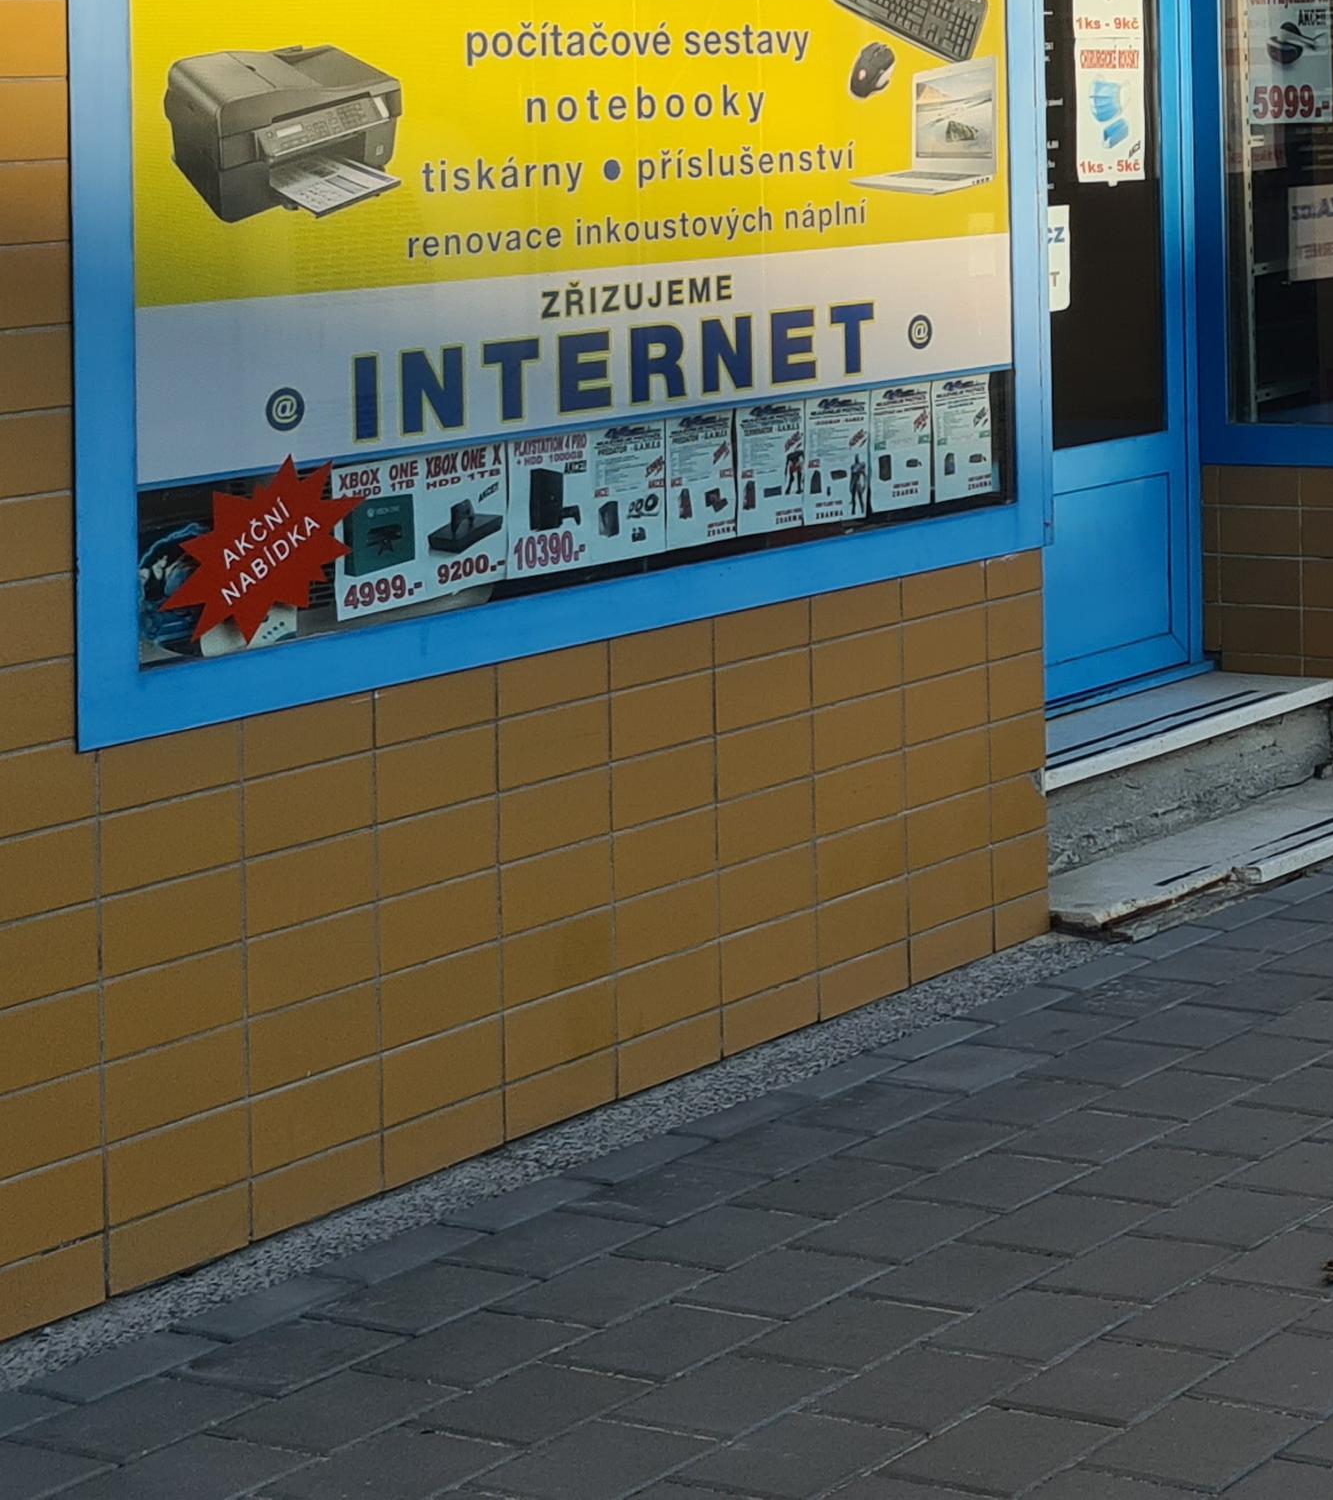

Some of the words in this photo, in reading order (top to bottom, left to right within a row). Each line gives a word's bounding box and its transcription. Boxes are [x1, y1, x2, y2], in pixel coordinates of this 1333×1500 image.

[465, 20, 673, 68] počítačové
[683, 26, 812, 62] sestavy
[1076, 18, 1101, 30] 1ks
[1113, 16, 1140, 30] 9kč
[525, 82, 766, 124] notebooky
[420, 155, 584, 195] tiskárny
[636, 140, 856, 190] příslušenství
[1079, 161, 1104, 175] 1ks
[1116, 159, 1141, 173] 5kč
[405, 221, 563, 261] renovace
[574, 204, 775, 246] inkoustových
[782, 199, 868, 233] náplní
[539, 271, 734, 321] ZŘIZUJEME
[350, 300, 877, 445] INTERNET
[338, 467, 381, 492] XBOX
[388, 460, 419, 482] ONE
[425, 448, 458, 480] XBOX
[460, 444, 486, 475] ONE
[221, 496, 292, 570] AKČNÍ
[220, 515, 321, 606] NABÍDKA
